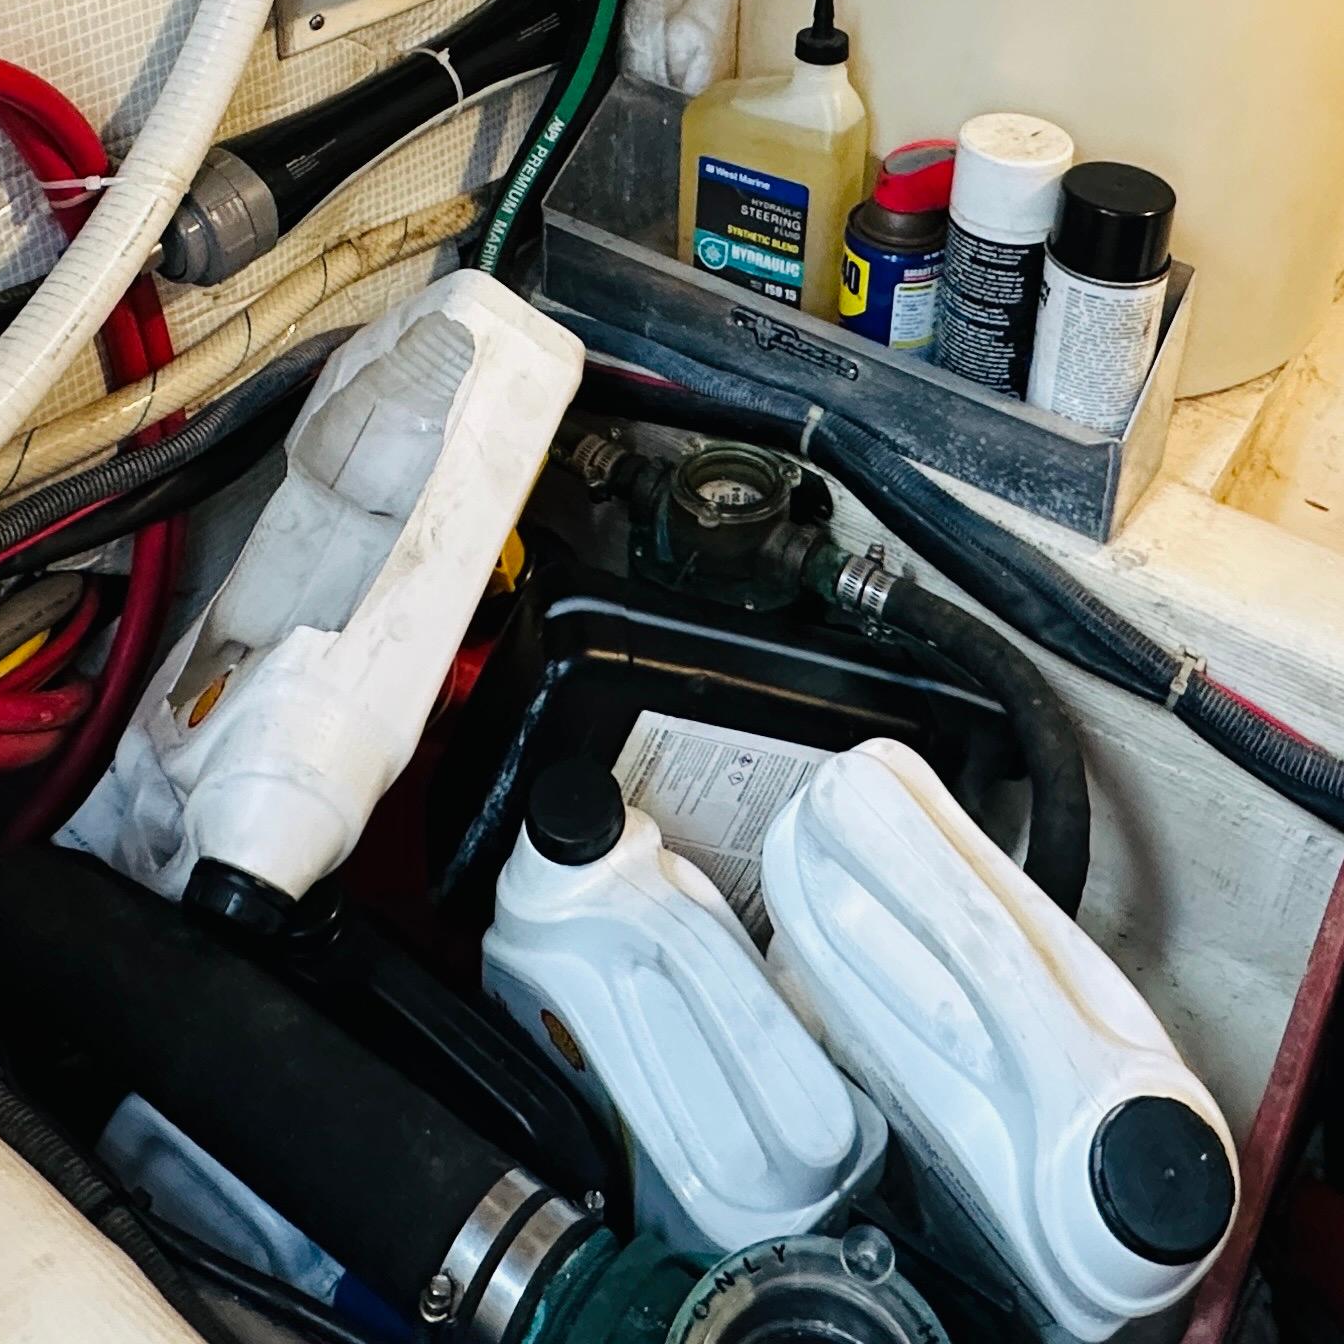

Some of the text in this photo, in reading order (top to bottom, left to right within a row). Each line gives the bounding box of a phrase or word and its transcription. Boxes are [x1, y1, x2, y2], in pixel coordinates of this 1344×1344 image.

[502, 144, 548, 215] PREMIUM
[716, 166, 771, 191] West Marine
[740, 205, 801, 232] STEERING
[751, 198, 802, 219] HYDRAULIC
[727, 224, 799, 254] SYNTHETIC BLEND
[773, 227, 801, 241] FLUID
[731, 244, 800, 277] HYDRAULIC
[765, 283, 797, 302] ISO 15
